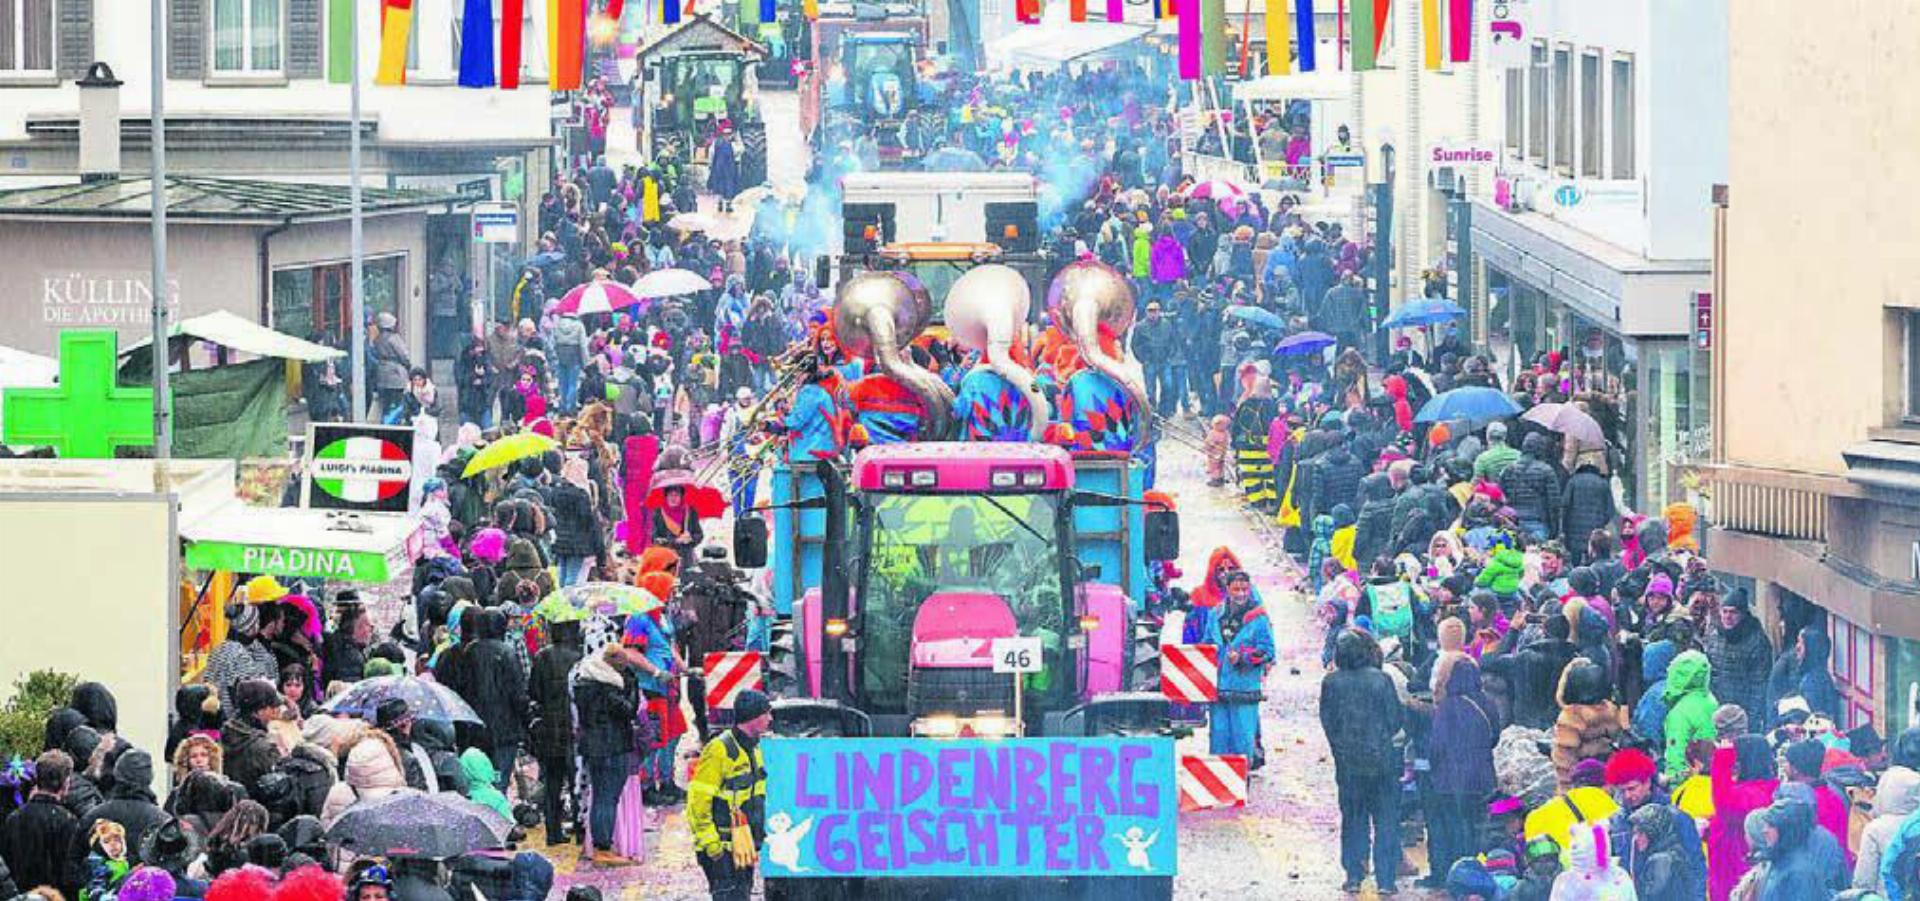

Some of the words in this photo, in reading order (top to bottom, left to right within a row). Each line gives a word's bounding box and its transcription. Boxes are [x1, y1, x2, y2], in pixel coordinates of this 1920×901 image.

[1433, 147, 1493, 161] Sunrise
[44, 306, 73, 321] DIE
[360, 464, 402, 475] PIADINA
[243, 546, 356, 577] PIADINA
[1004, 649, 1031, 668] 46
[794, 743, 1160, 819] LINDENBERG
[814, 807, 1111, 873] GEISCHTER
